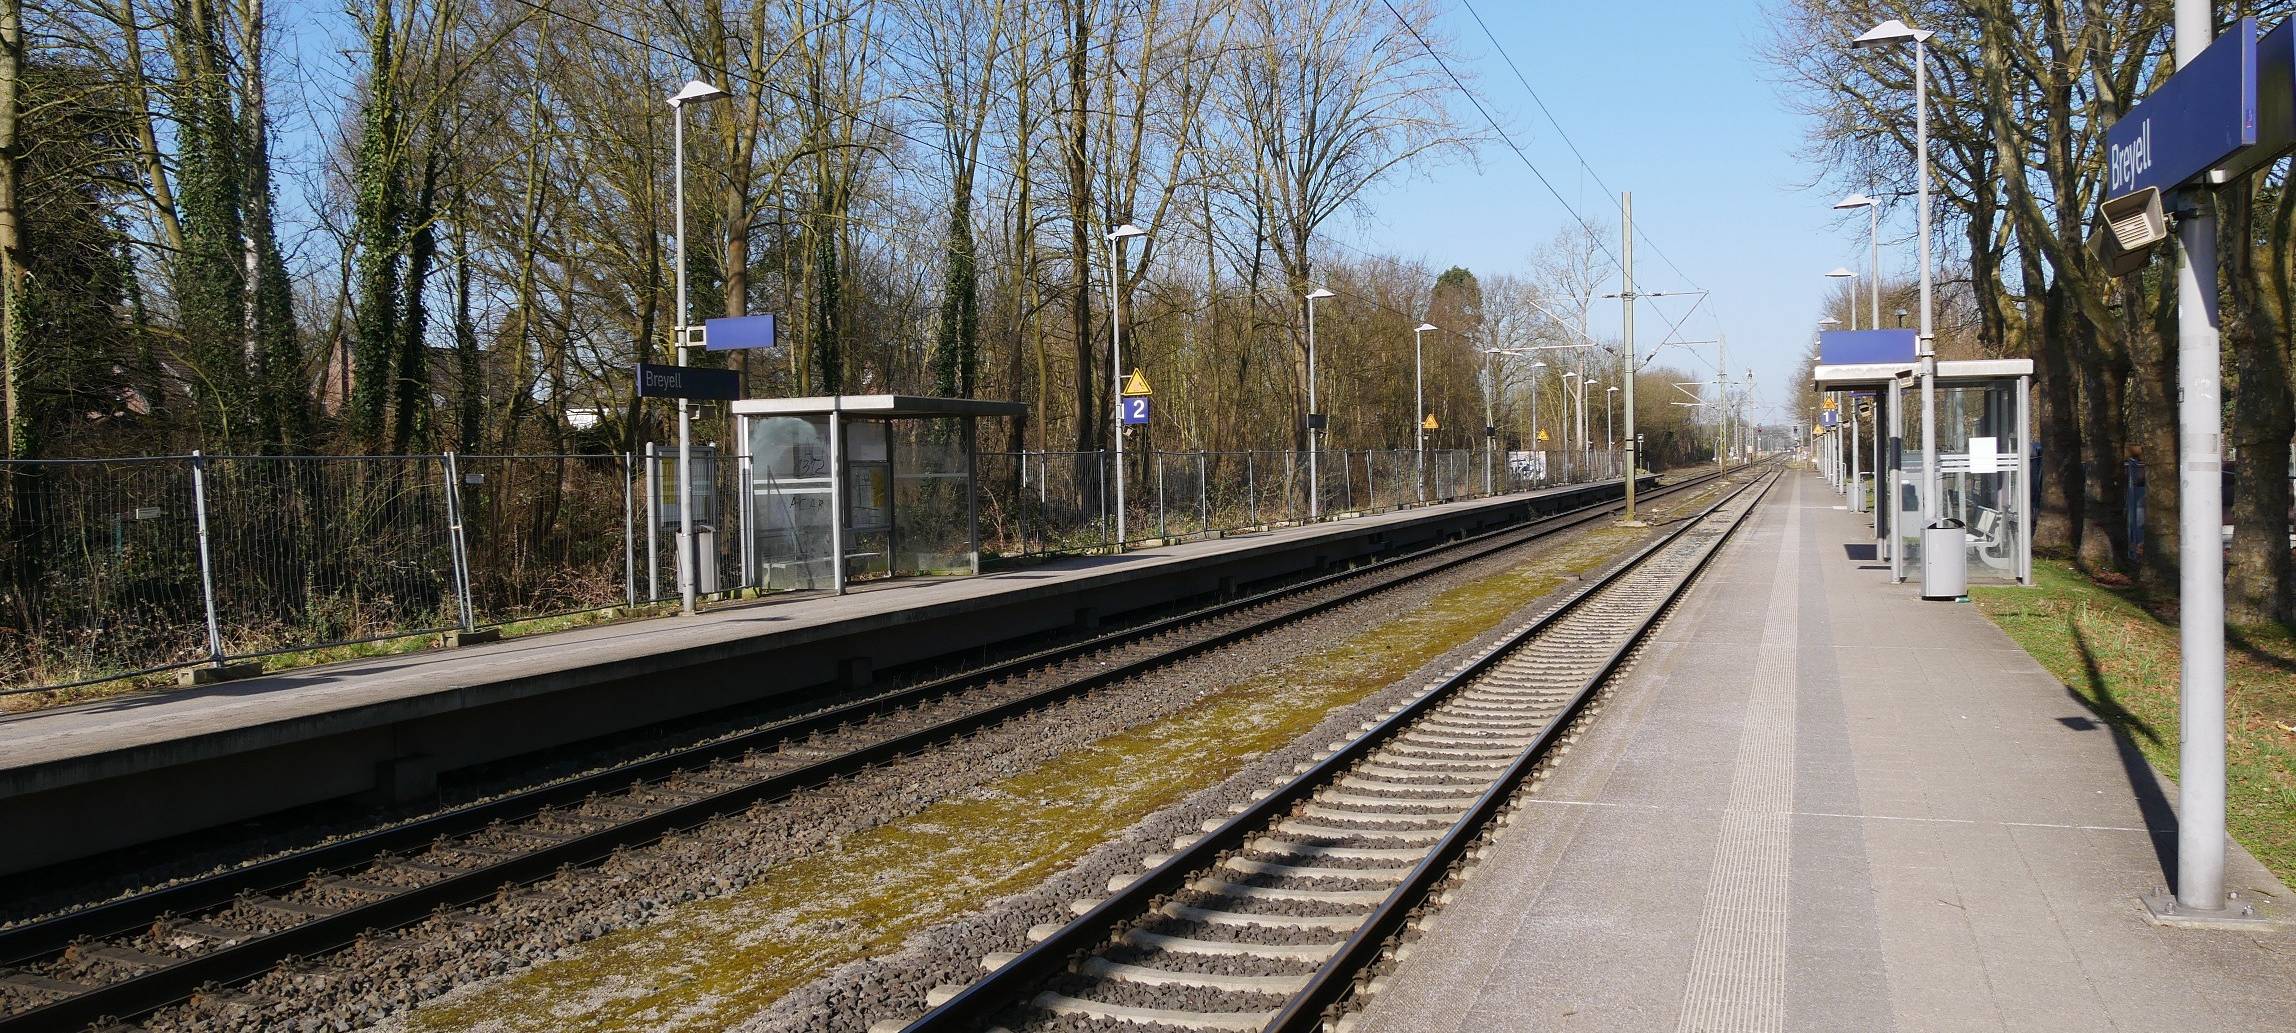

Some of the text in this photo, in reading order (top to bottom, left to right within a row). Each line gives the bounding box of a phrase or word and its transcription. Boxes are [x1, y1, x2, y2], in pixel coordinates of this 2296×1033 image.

[2112, 118, 2152, 191] Breyell
[646, 370, 682, 391] Breyell
[1133, 400, 1145, 418] 2
[1823, 411, 1829, 422] 1
